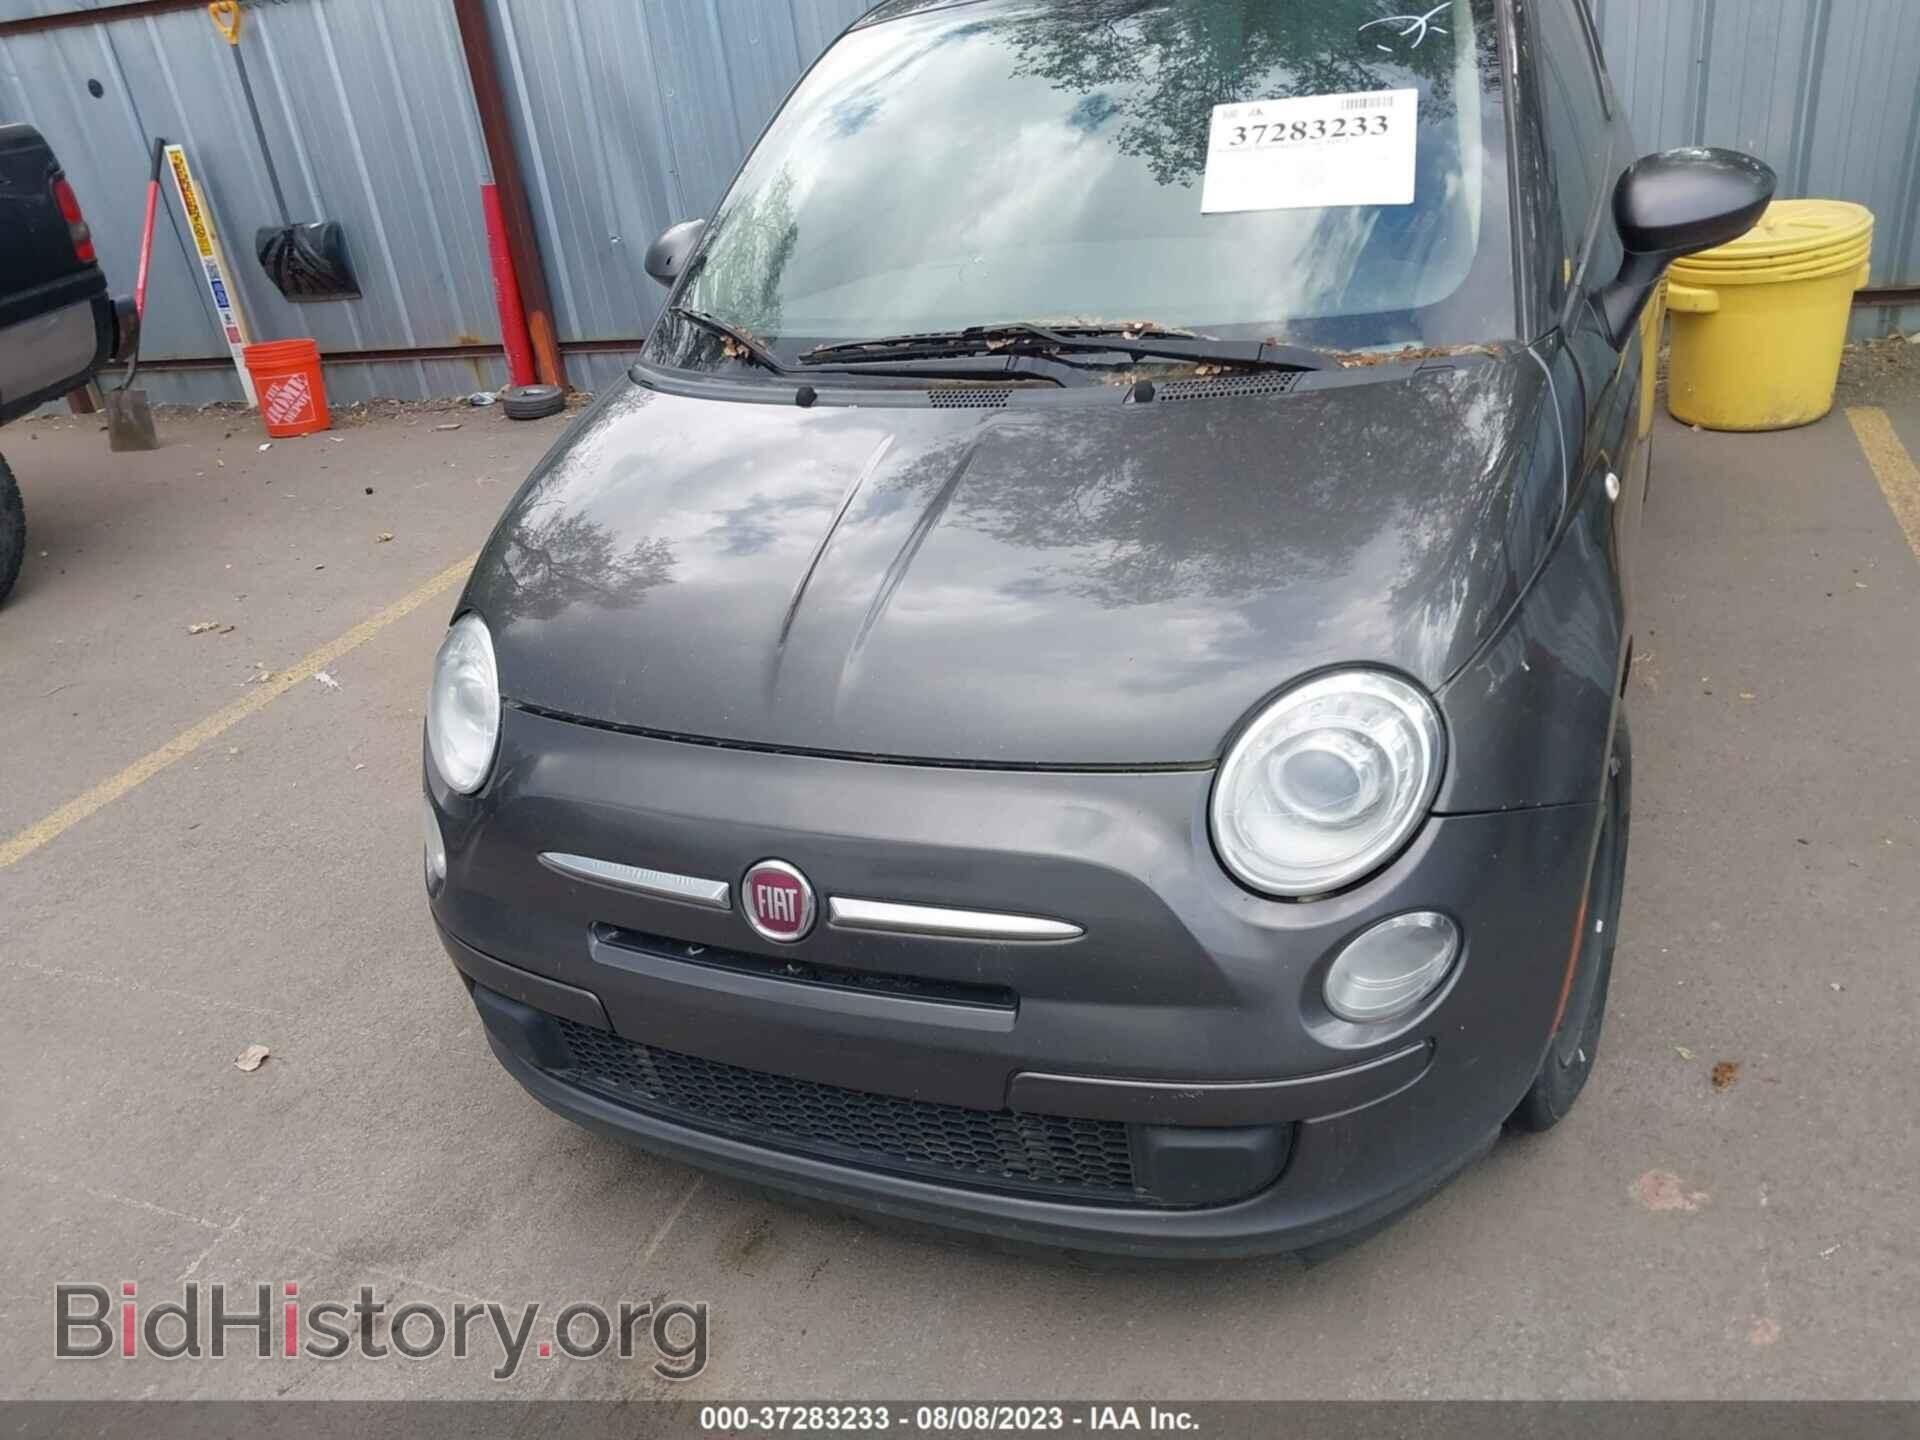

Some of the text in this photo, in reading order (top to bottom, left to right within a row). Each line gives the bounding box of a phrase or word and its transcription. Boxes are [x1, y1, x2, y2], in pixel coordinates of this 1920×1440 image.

[1229, 115, 1389, 146] 37283233
[267, 374, 306, 424] HOME
[757, 884, 798, 922] FIAT
